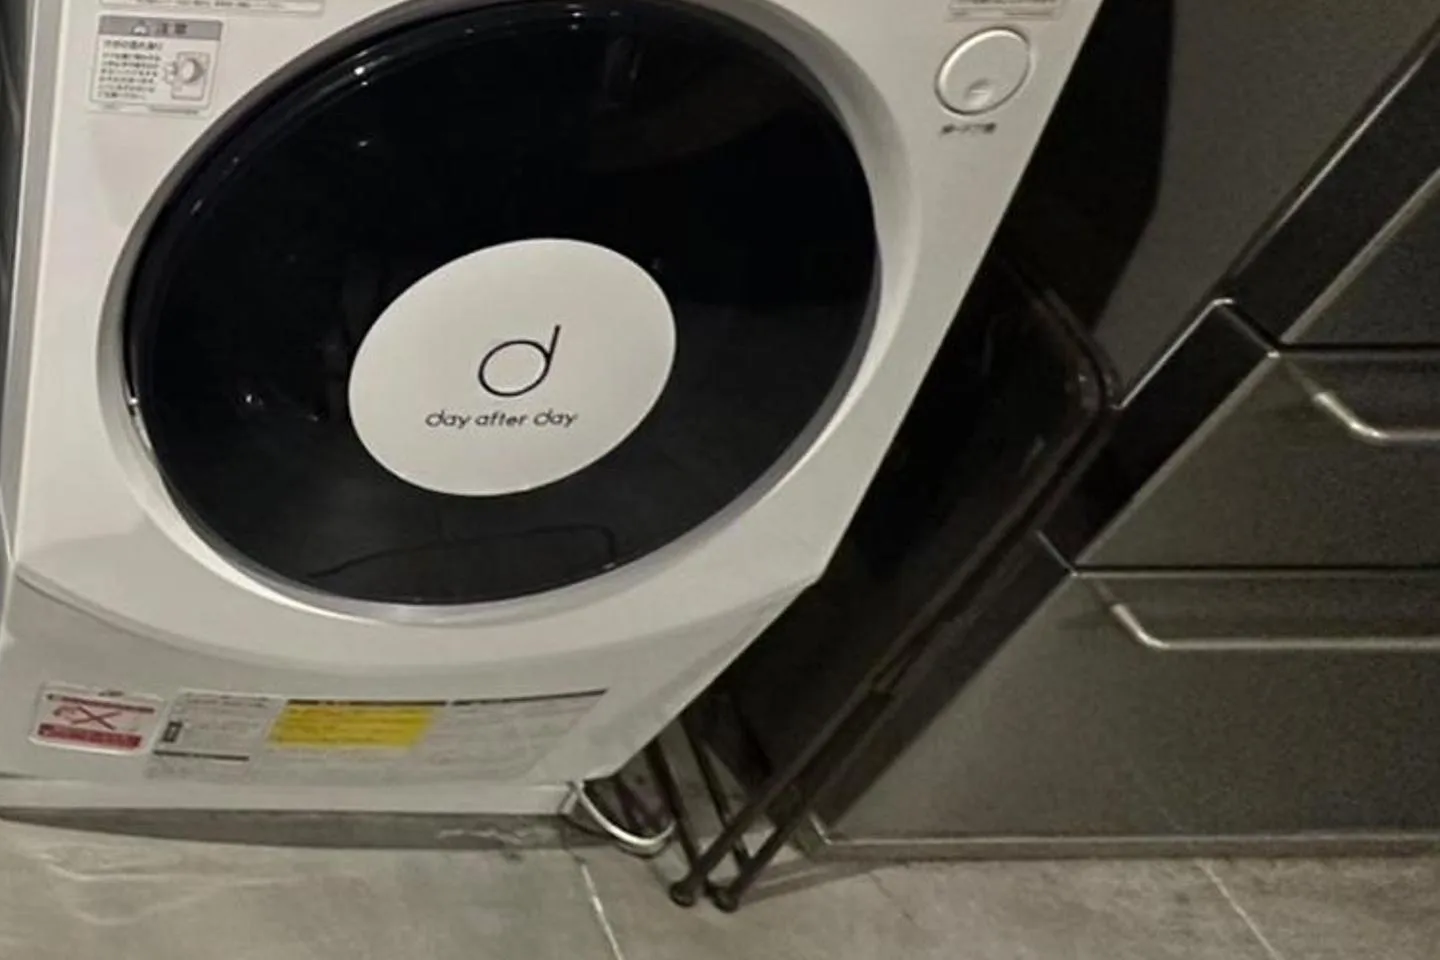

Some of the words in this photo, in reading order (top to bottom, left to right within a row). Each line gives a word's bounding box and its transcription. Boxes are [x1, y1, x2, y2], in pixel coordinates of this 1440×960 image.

[478, 324, 561, 398] d
[425, 409, 472, 430] day
[474, 410, 529, 428] after
[533, 408, 578, 429] day
